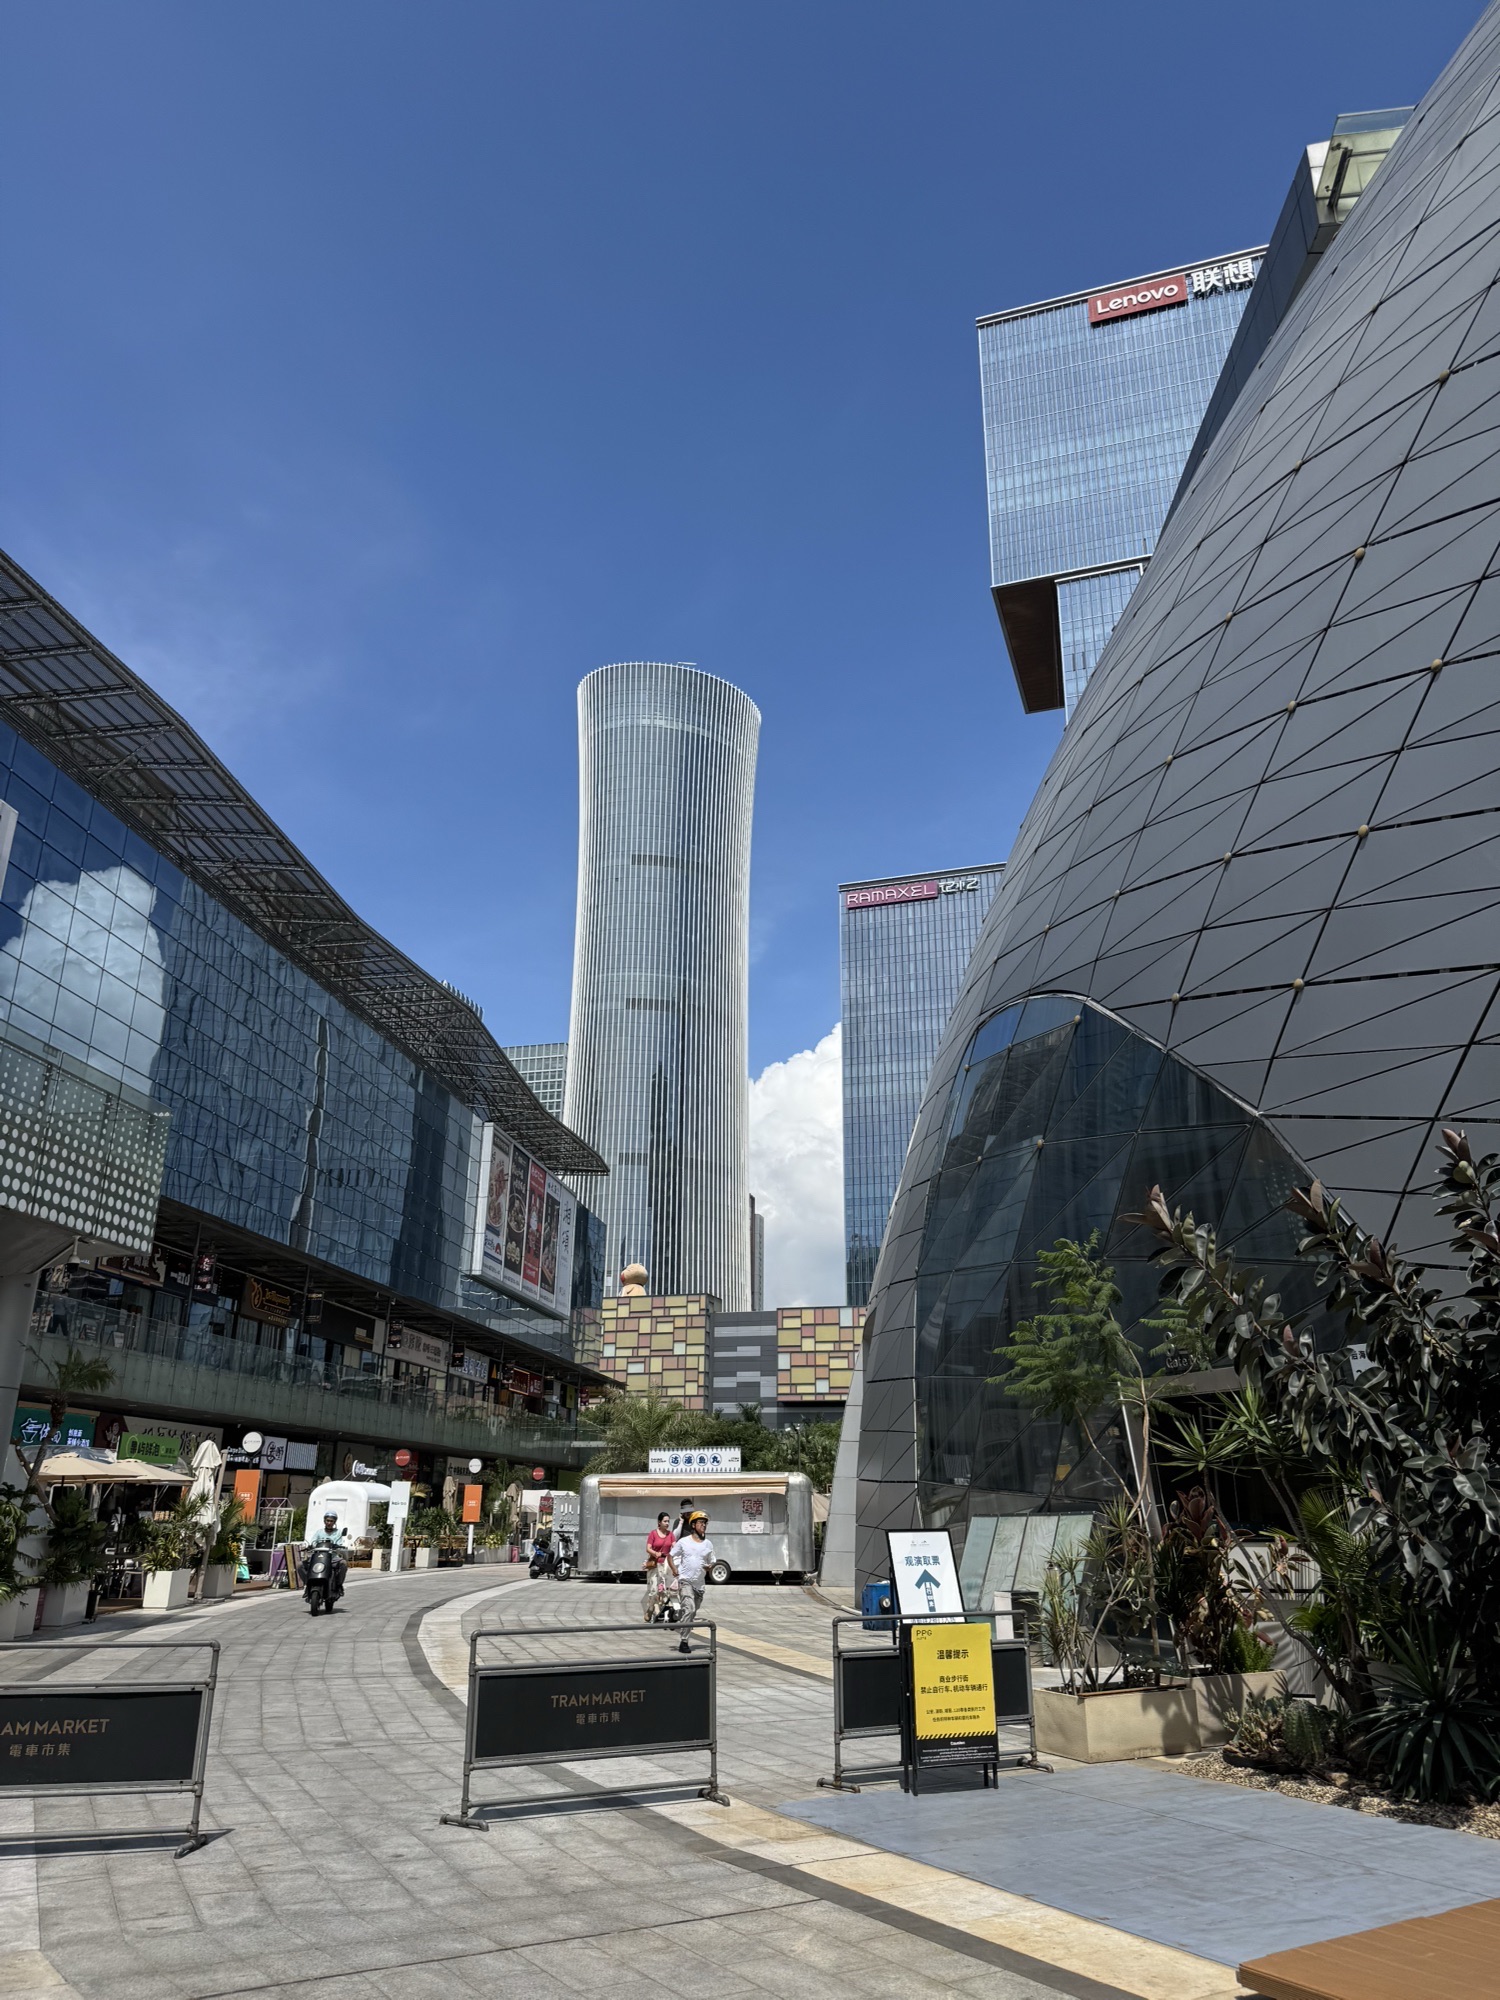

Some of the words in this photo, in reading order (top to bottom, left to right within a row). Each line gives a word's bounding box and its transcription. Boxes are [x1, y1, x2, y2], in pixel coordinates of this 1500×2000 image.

[1191, 258, 1255, 294] 联想
[1097, 283, 1179, 315] Lenovo
[847, 884, 936, 905] RAMAXEL
[1166, 1357, 1189, 1369] Gate
[905, 1555, 940, 1566] 观演取票
[916, 1629, 932, 1637] PPG
[937, 1649, 969, 1660] 温馨提示
[939, 1675, 969, 1683] 商业步行街
[921, 1684, 988, 1694] 禁止自行车、机动车辆通行
[551, 1693, 590, 1708] TRAM
[592, 1690, 646, 1705] MARKET
[576, 1711, 620, 1725] 電車市集
[34, 1719, 110, 1735] MARKET
[9, 1743, 71, 1758] 電車市集
